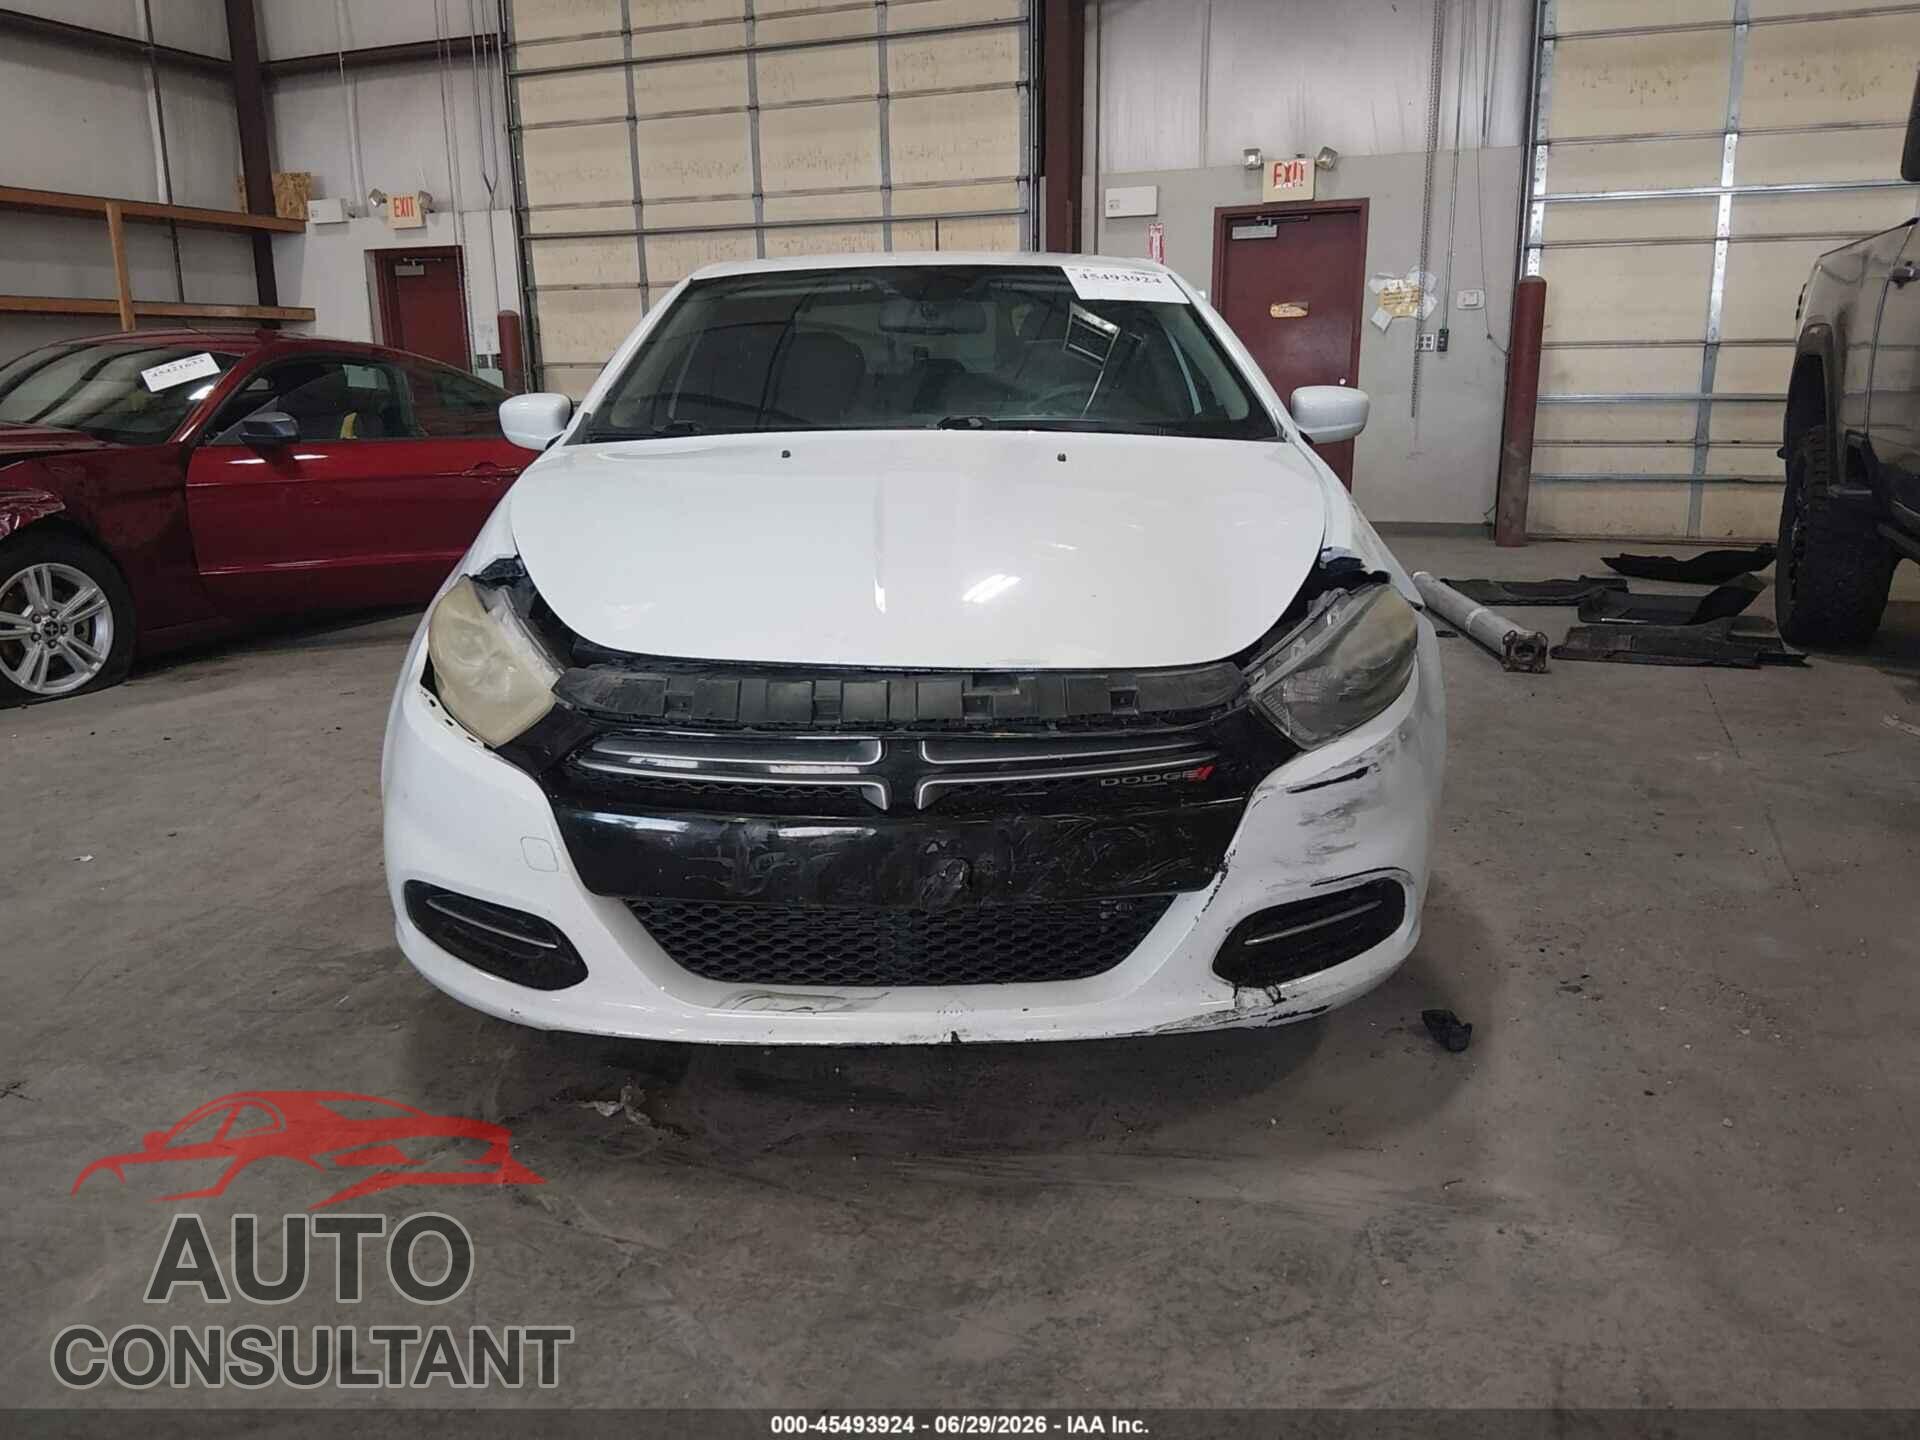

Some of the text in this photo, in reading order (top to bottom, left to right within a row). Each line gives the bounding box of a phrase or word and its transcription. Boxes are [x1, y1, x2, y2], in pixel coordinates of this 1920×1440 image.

[1273, 161, 1305, 187] EXIT
[393, 196, 414, 217] EXIT
[1101, 768, 1200, 787] DODGE
